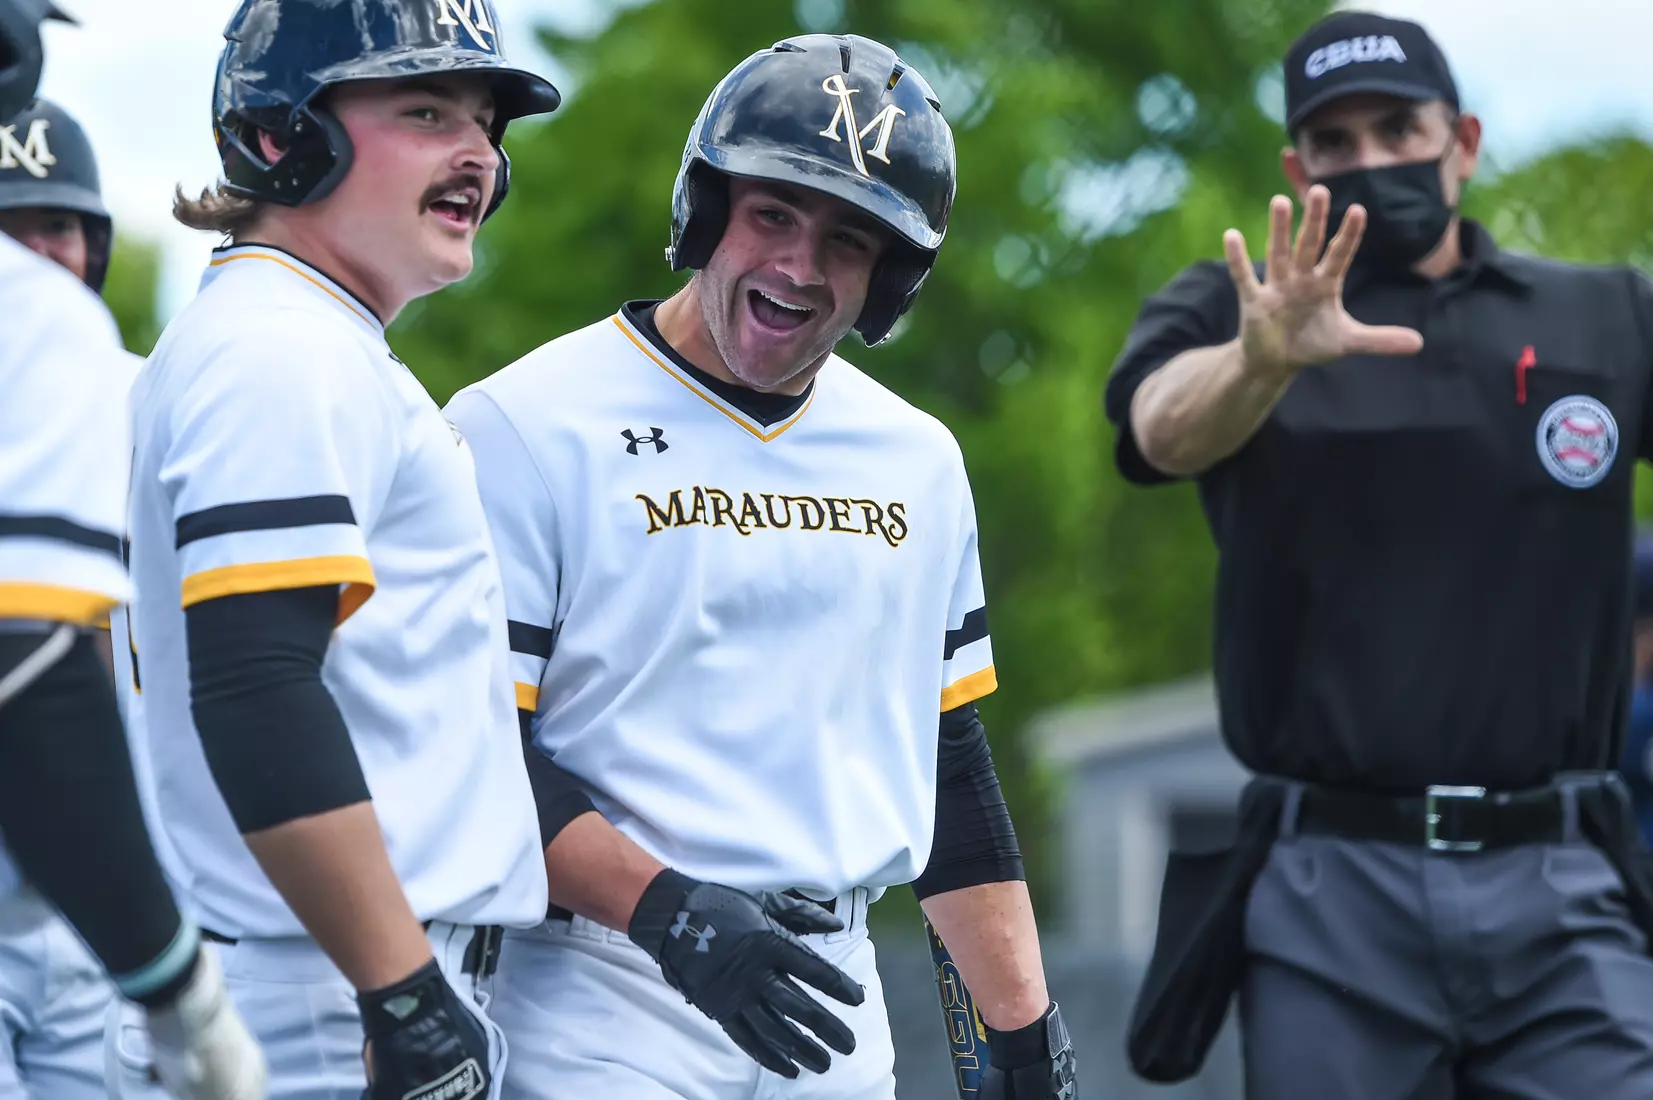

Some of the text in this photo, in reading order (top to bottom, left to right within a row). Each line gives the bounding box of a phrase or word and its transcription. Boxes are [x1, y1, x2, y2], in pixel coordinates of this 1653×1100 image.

[1305, 35, 1407, 79] CBUA
[819, 75, 906, 177] M
[635, 485, 908, 547] MARAUDERS
